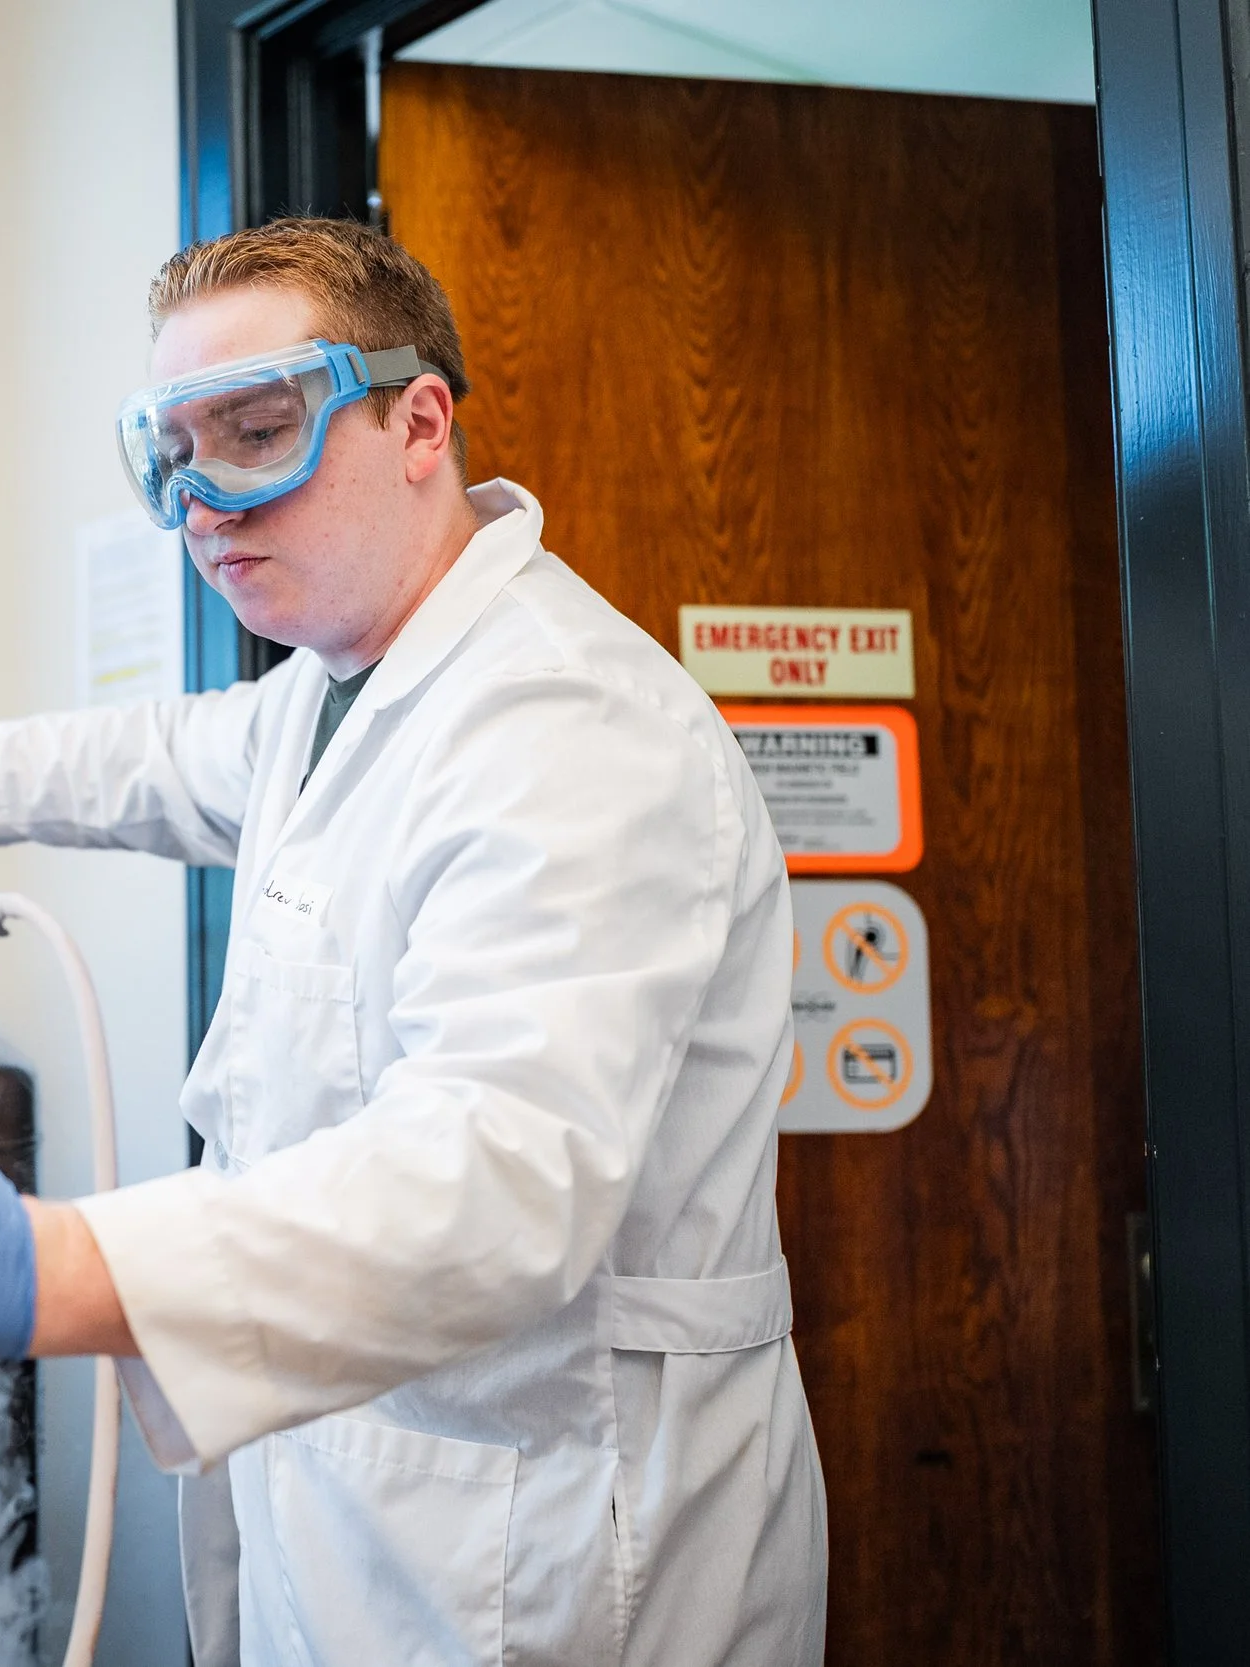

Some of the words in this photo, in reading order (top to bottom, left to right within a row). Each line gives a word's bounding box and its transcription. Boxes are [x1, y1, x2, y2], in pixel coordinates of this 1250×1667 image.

[693, 623, 841, 653] EMERGENCY
[849, 625, 900, 654] EXIT
[769, 657, 828, 687] ONLY
